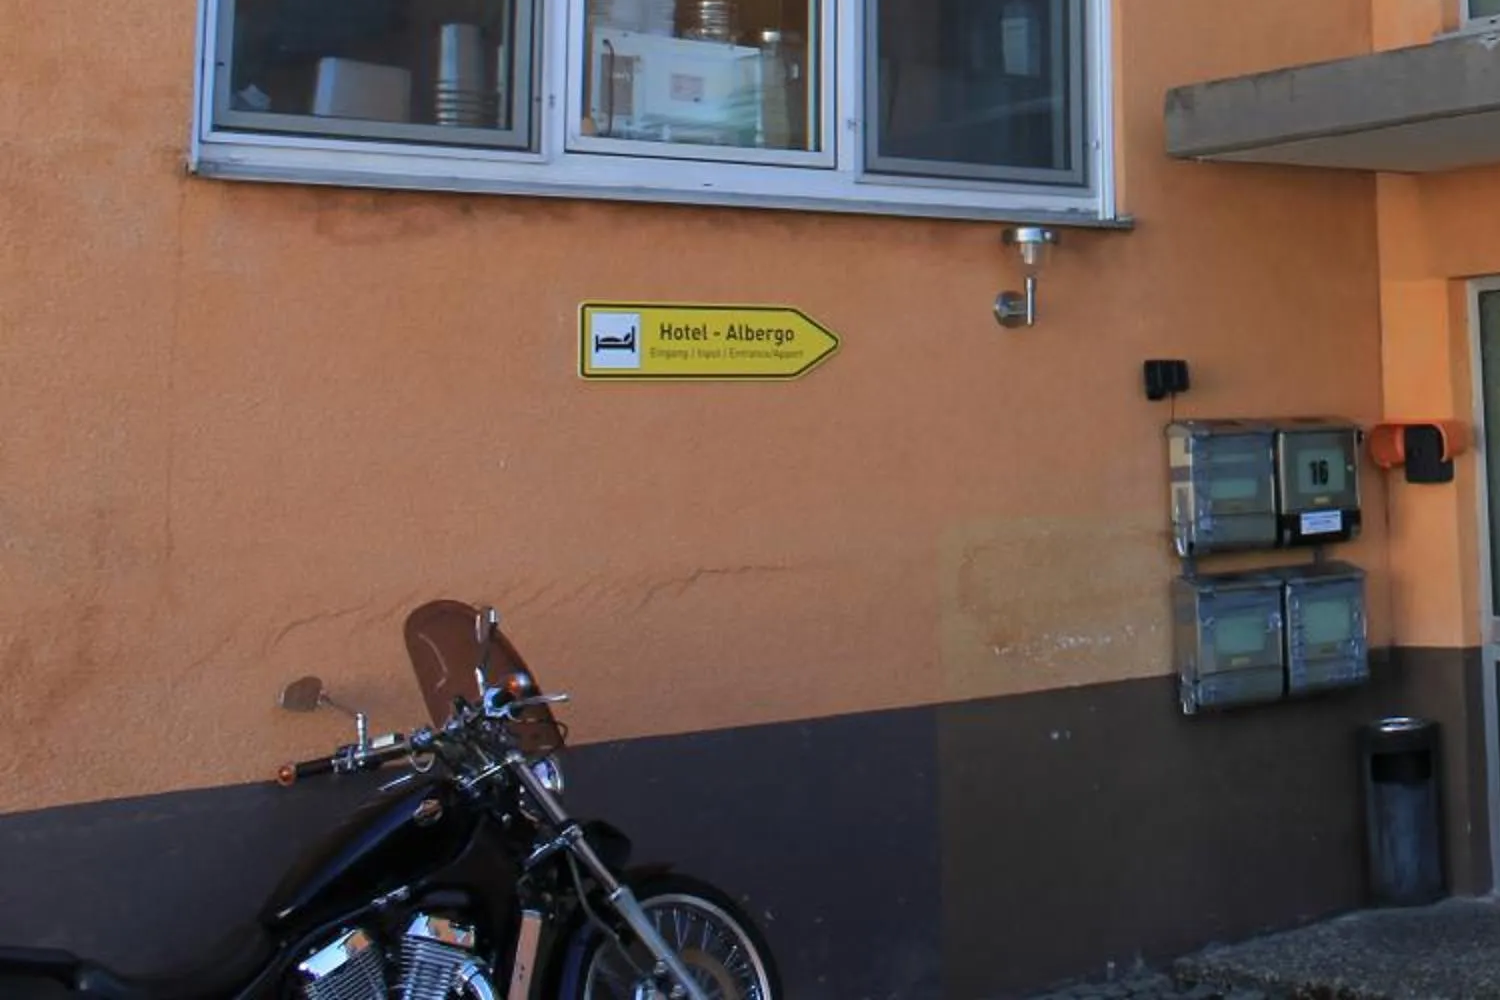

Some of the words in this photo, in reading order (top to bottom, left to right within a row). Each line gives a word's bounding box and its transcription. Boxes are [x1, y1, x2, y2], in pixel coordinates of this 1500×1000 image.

[659, 323, 708, 342] Hotel
[726, 324, 796, 346] Albergo
[1308, 460, 1329, 486] 16
